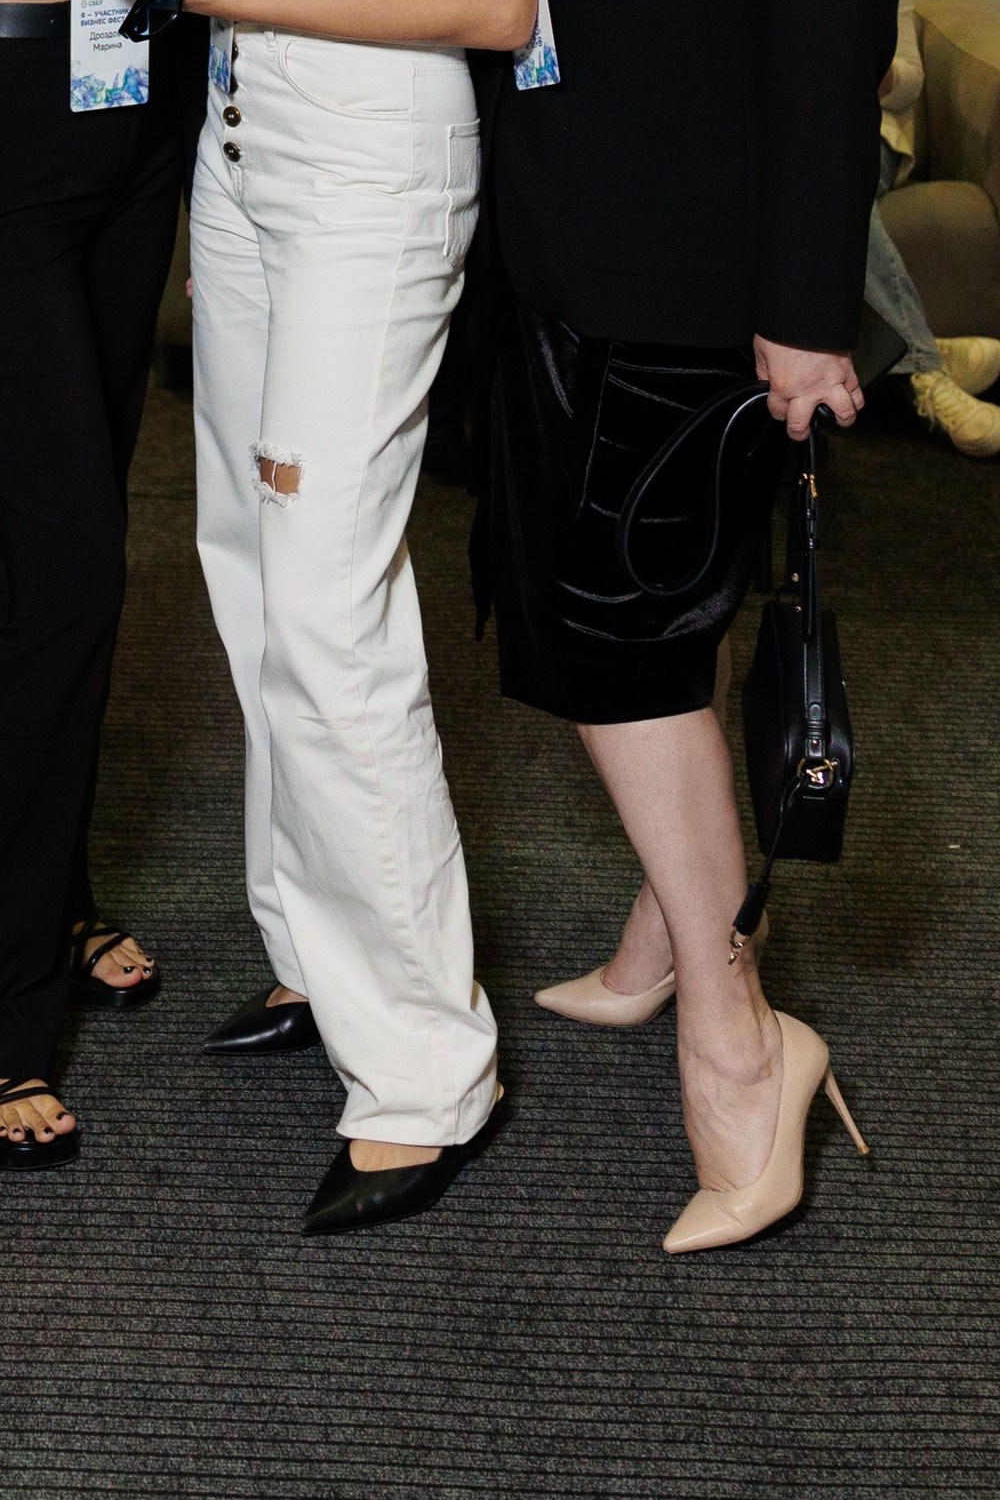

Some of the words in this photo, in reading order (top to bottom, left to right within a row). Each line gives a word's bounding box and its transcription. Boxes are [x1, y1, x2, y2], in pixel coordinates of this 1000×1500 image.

[94, 8, 129, 17] УЧАСТНИК
[81, 18, 107, 26] БИЗНЕС
[89, 31, 121, 41] Дроздов
[93, 42, 122, 51] Марина
